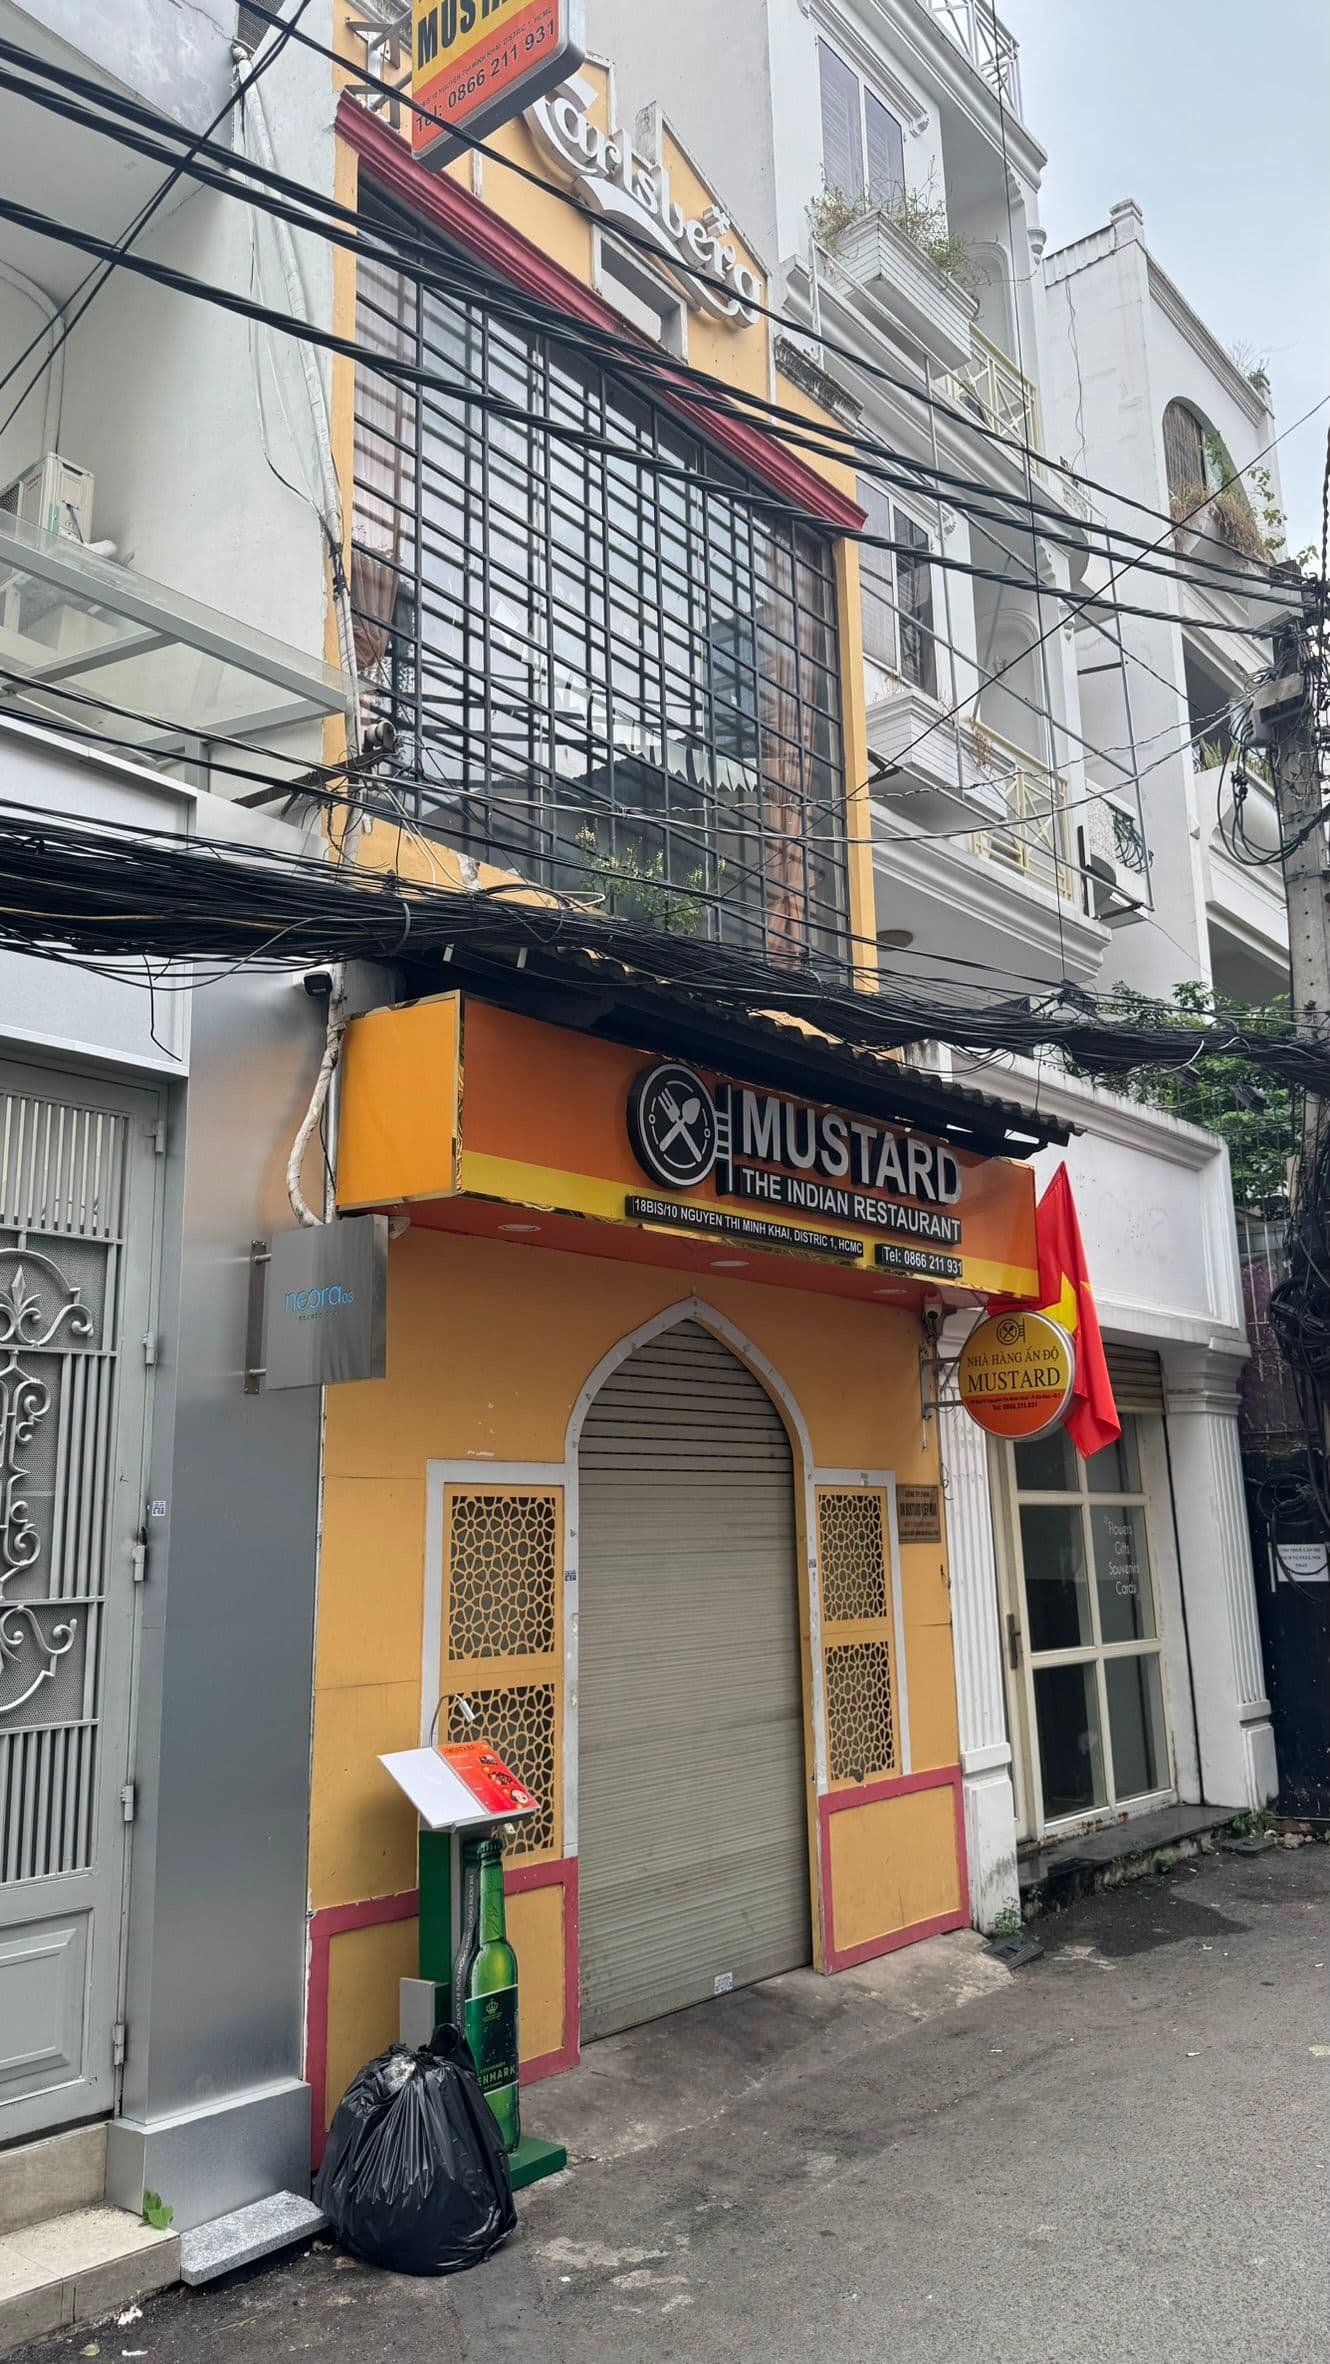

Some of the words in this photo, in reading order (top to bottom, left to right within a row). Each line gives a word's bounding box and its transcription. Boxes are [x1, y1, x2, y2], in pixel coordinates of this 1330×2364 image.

[448, 69, 485, 108] 0866
[490, 44, 517, 76] 211
[524, 19, 554, 51] 931
[742, 1090, 963, 1205] MUSTARD
[743, 1168, 781, 1200] THE
[787, 1180, 848, 1219] INDIAN
[854, 1193, 960, 1240] RESTAURANT
[634, 1198, 678, 1219] 18BIS/10
[681, 1207, 722, 1227] NGUYEN
[725, 1216, 741, 1230] THI
[743, 1220, 766, 1235] MINH
[768, 1224, 792, 1242] KHAI,
[794, 1230, 828, 1246] DISTRIC
[839, 1238, 863, 1254] HCMC
[883, 1246, 902, 1264] Tel:
[904, 1250, 927, 1268] 0866
[929, 1255, 945, 1272] 211
[947, 1259, 962, 1275] 931
[967, 1352, 989, 1368] NHÀ
[992, 1350, 1022, 1366] HÀNG
[1024, 1346, 1041, 1362] ẤN
[1043, 1345, 1059, 1362] ĐỘ
[968, 1367, 1060, 1393] MUSTARD
[1116, 1580, 1136, 1596] Cards
